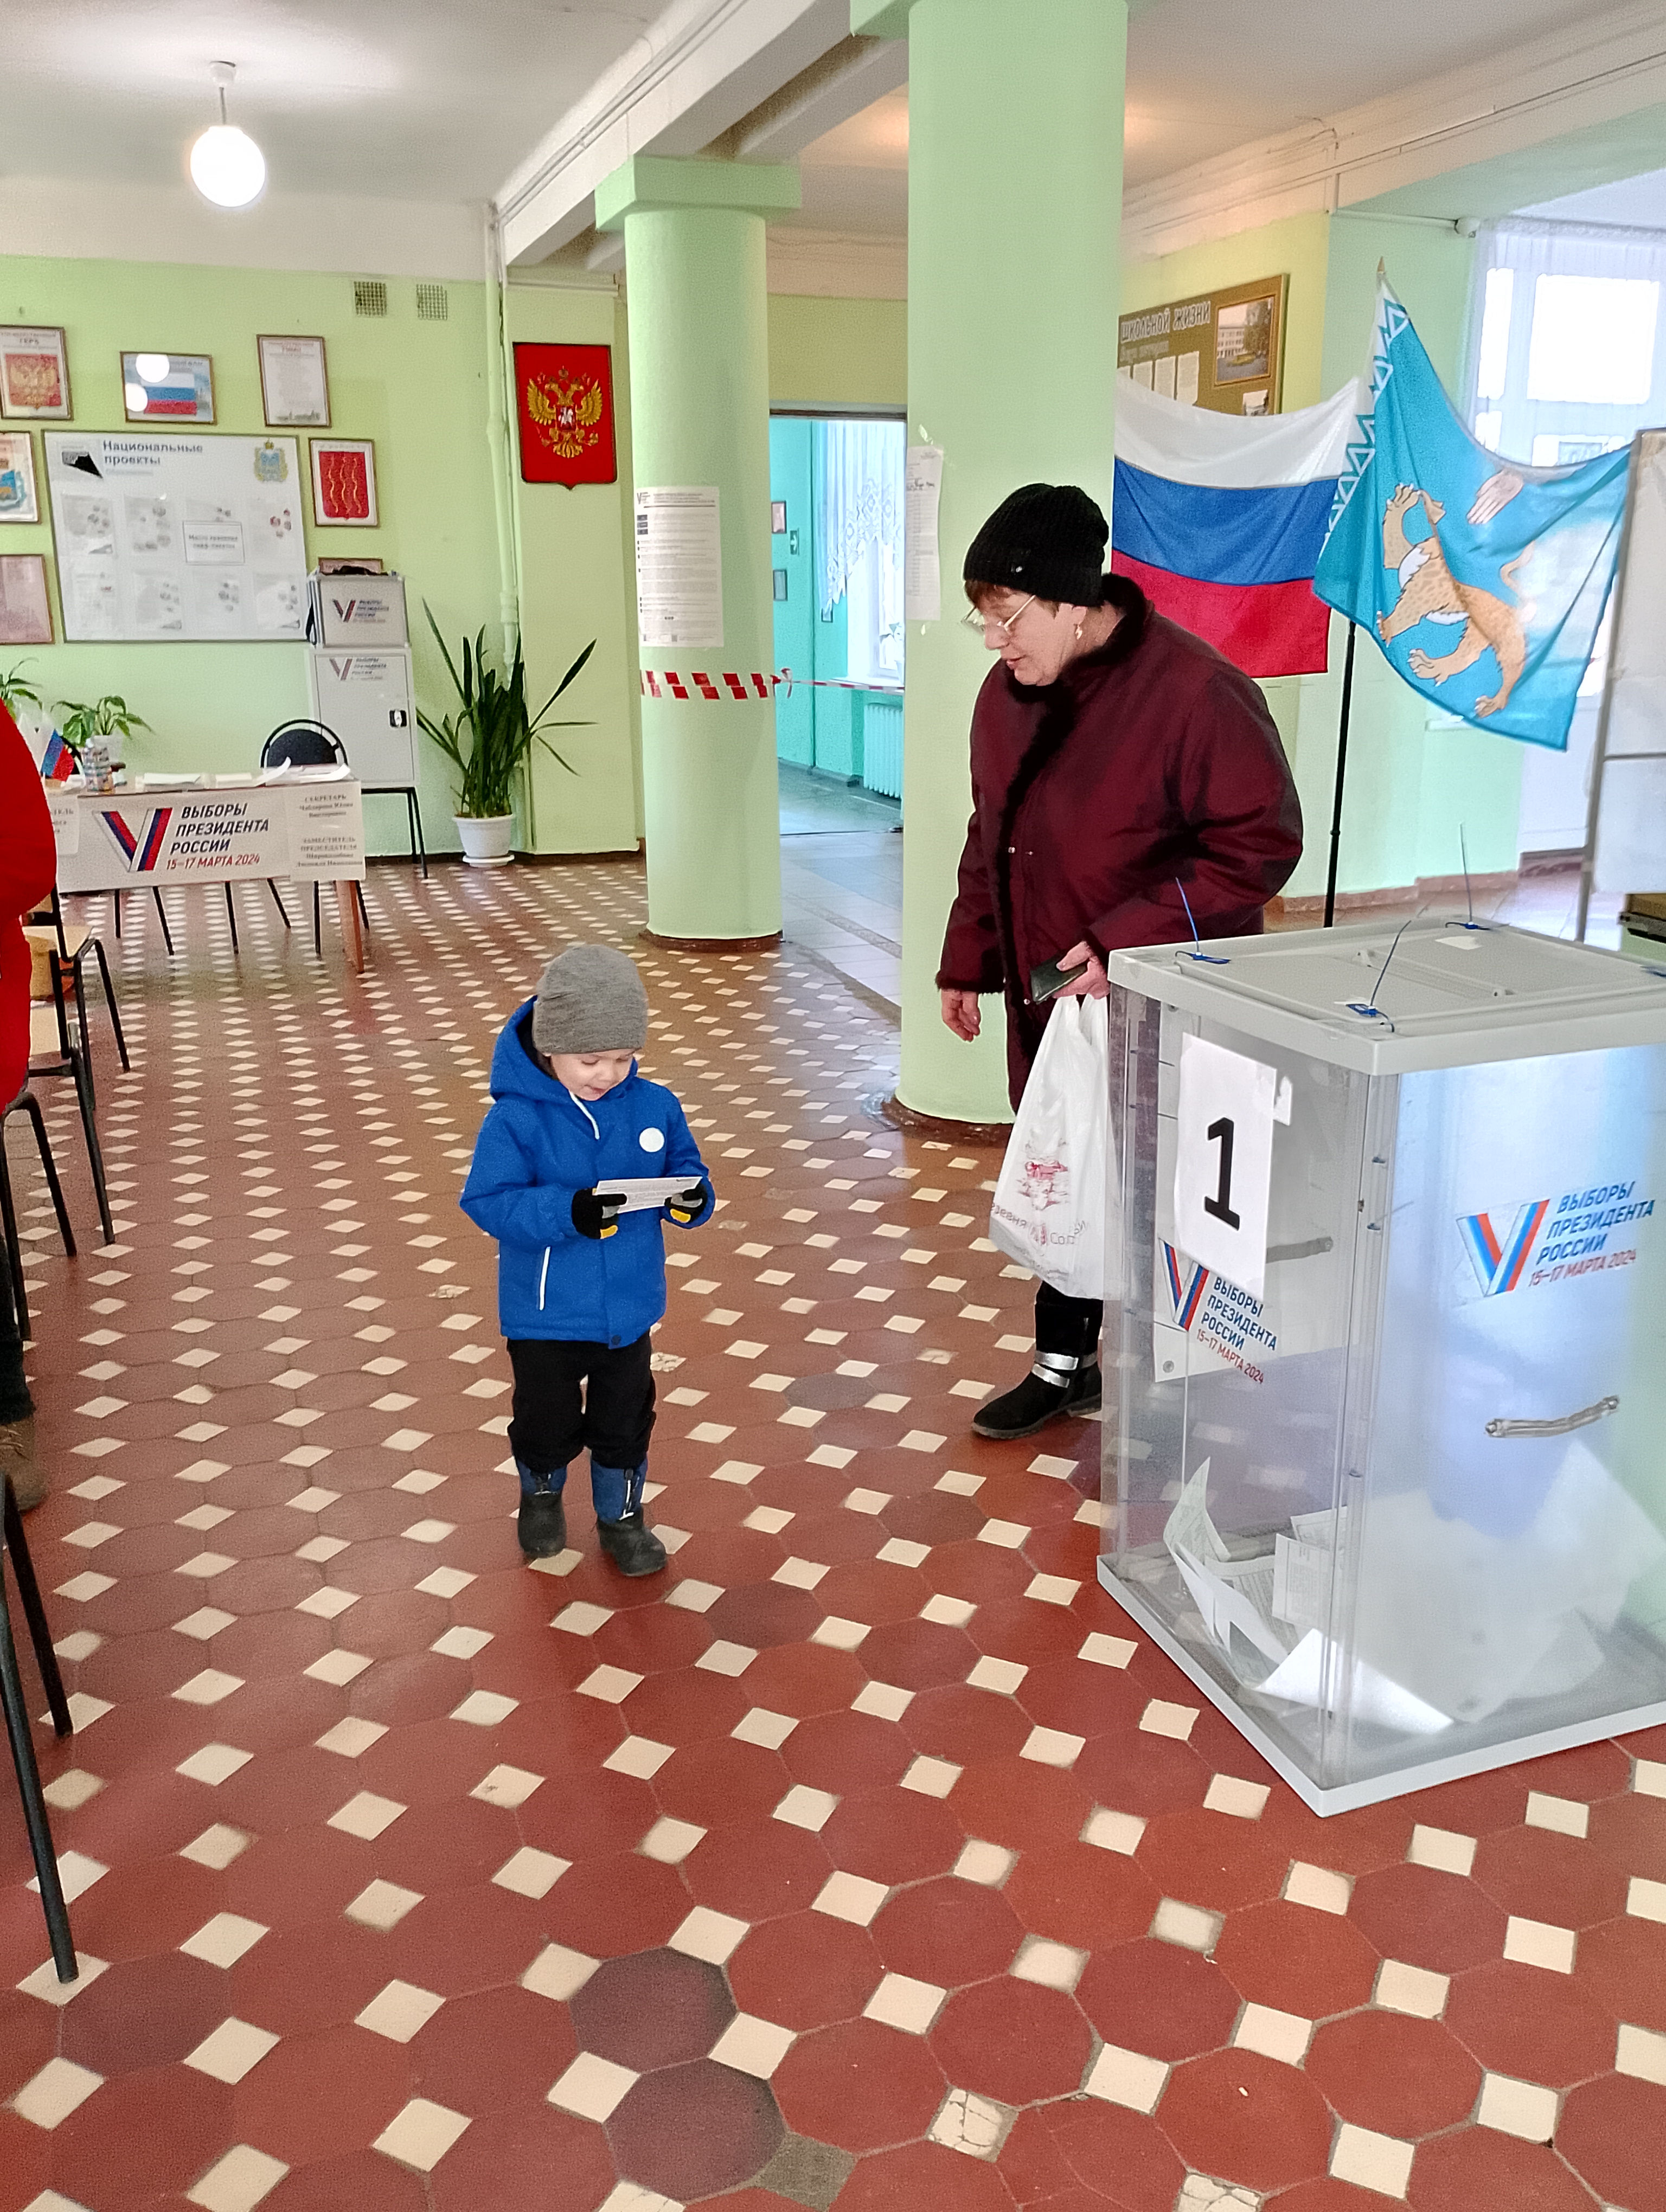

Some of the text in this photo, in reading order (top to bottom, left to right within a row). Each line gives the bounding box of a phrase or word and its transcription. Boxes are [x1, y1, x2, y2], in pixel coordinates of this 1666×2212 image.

[1120, 301, 1211, 344] ШКОЛЬНОЙ ЖИЗНИ
[103, 440, 203, 453] Национальные
[105, 455, 161, 466] проекты
[175, 818, 270, 837] ПРЕЗИДЕНТА
[181, 803, 248, 819] ВЫБОРЫ
[170, 839, 231, 855] РОССИИ
[197, 855, 233, 868] МАРТА
[235, 853, 260, 866] 2024
[1204, 1117, 1240, 1231] 1
[1556, 1181, 1636, 1214] ВЫБОРЫ
[1546, 1199, 1656, 1240] ПРЕЗИДЕНТА
[1536, 1233, 1608, 1266] РОССИИ
[1563, 1256, 1605, 1279] МАРТА
[1607, 1249, 1637, 1268] 2024
[1214, 1277, 1264, 1317] ВЫБОРЫ
[1201, 1311, 1245, 1351] РОССИИ
[1207, 1295, 1277, 1351] ПРЕЗИДЕНТА
[1217, 1343, 1244, 1371] МАРТА
[1244, 1362, 1264, 1384] 2024
